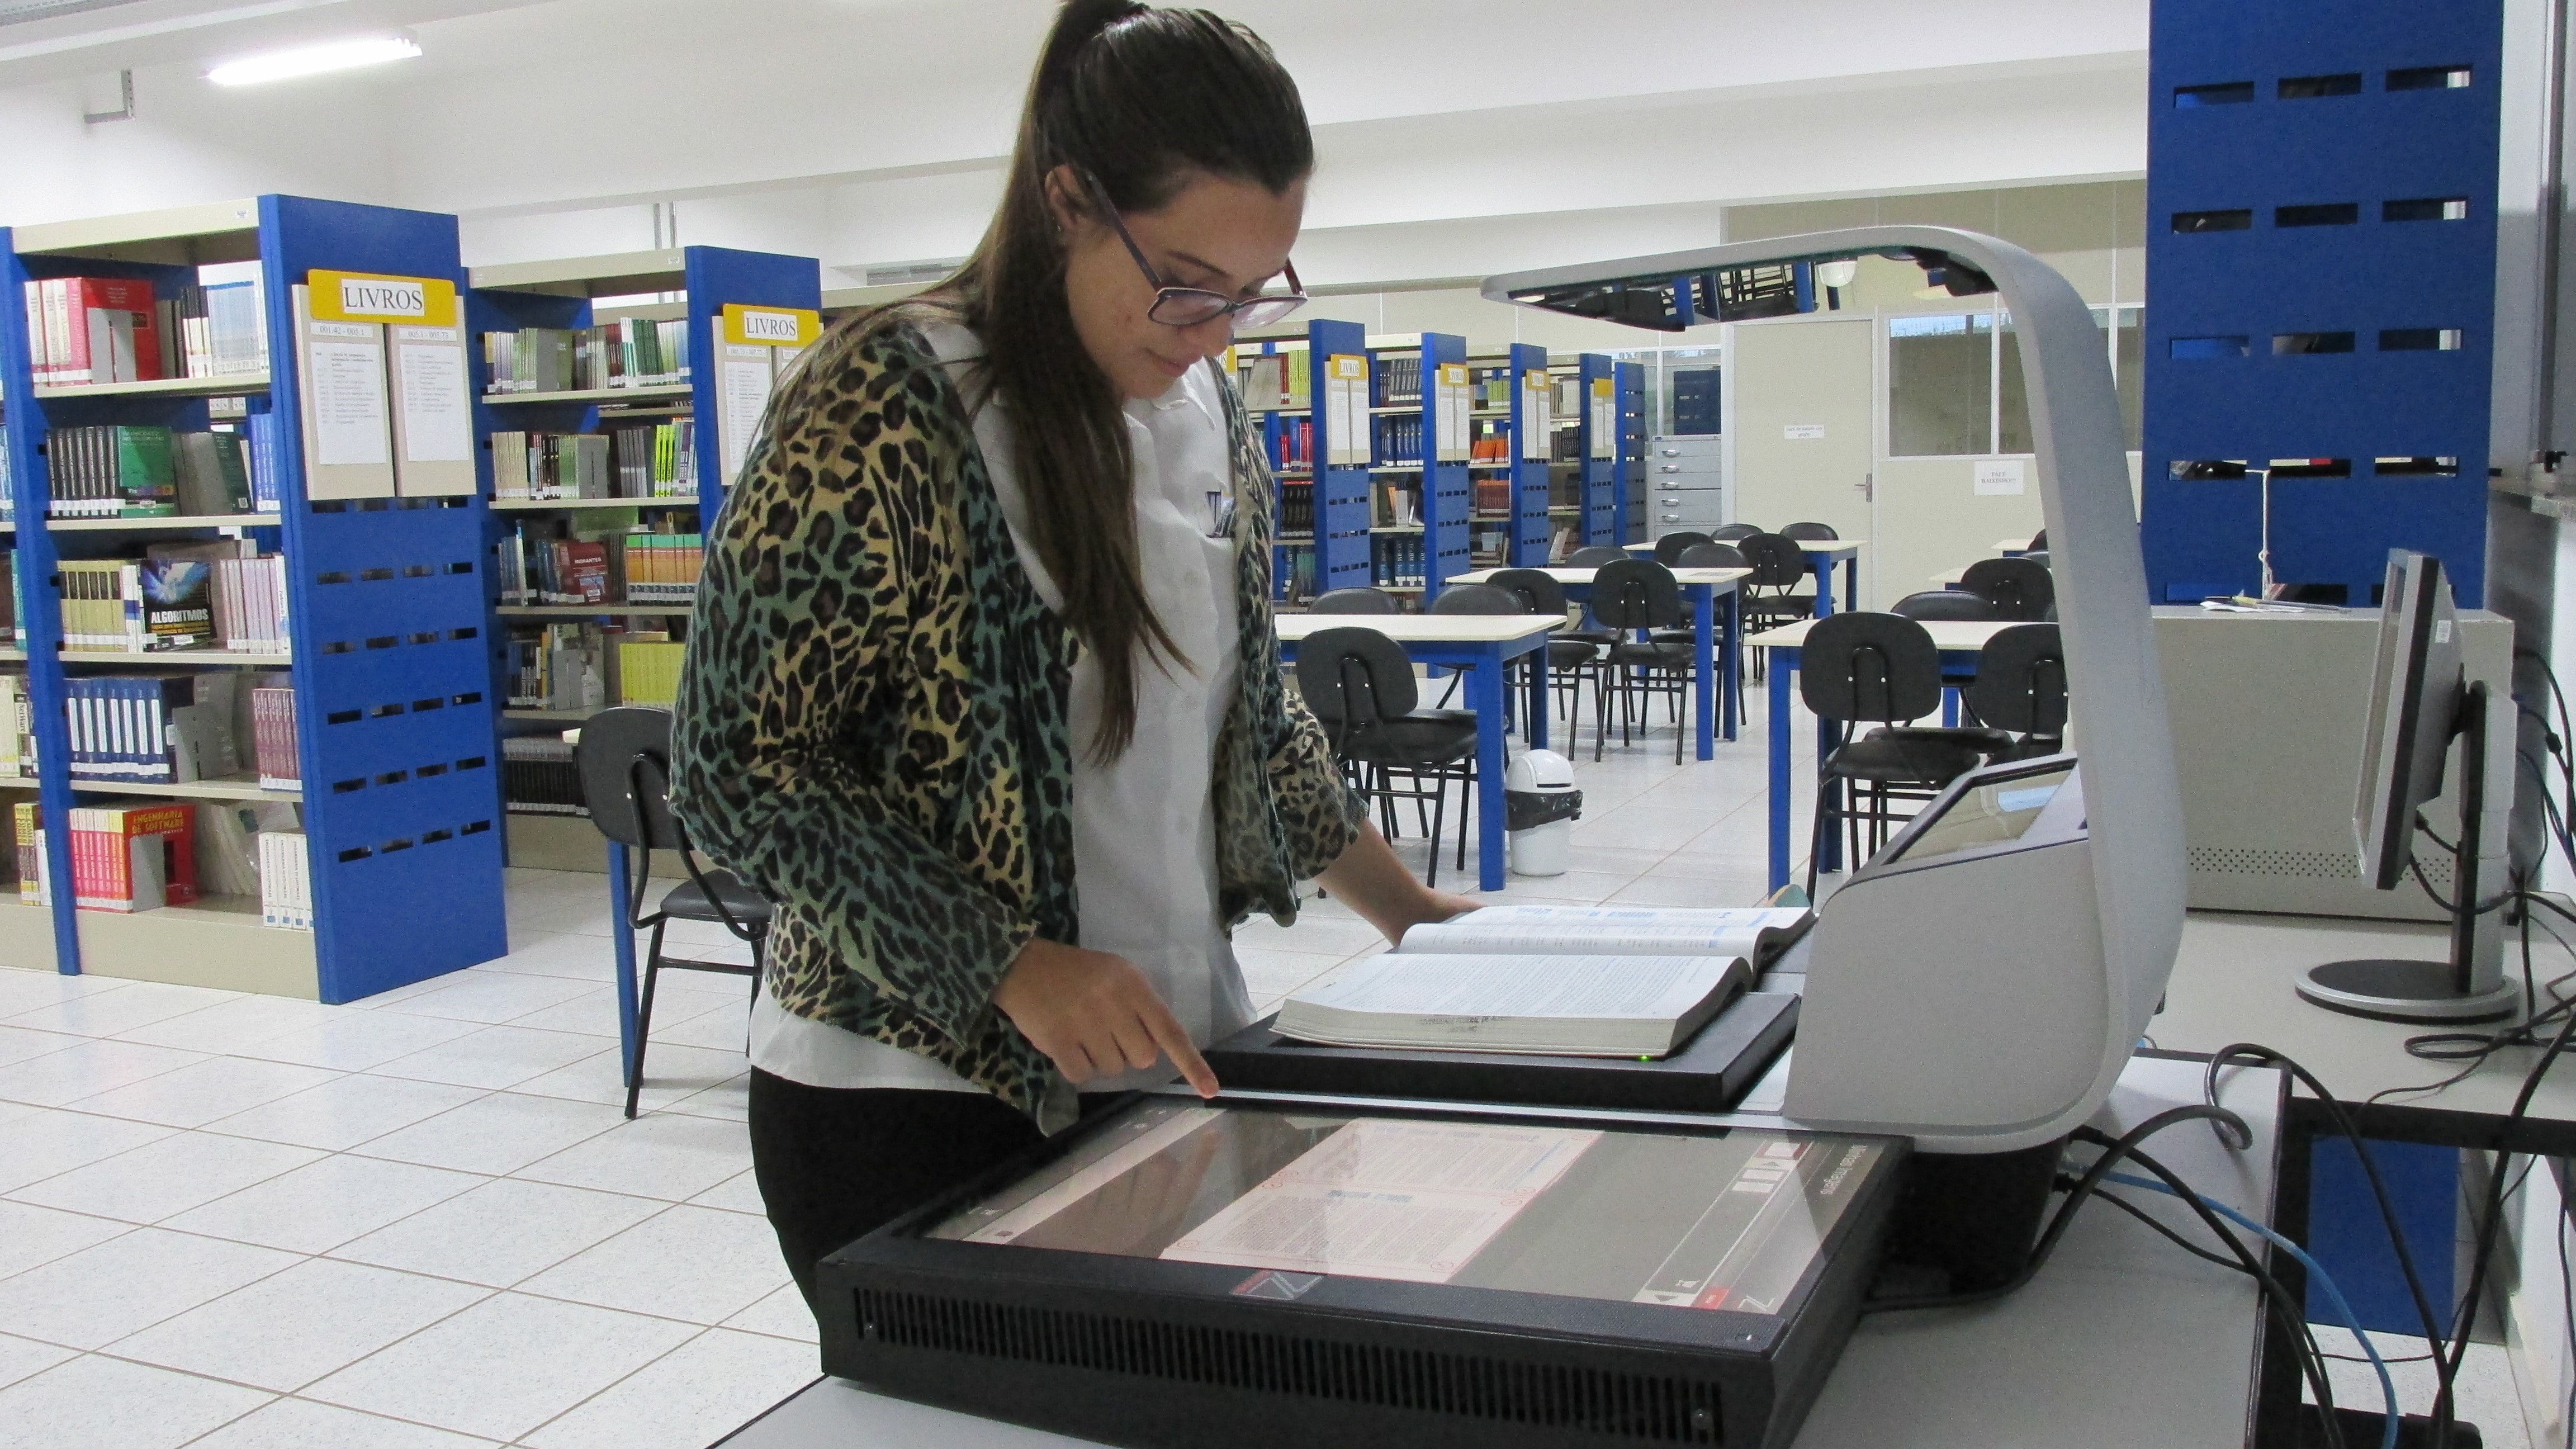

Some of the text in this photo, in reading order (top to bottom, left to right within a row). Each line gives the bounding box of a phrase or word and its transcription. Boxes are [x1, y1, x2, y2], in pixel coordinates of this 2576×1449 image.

[344, 287, 423, 310] LIVROS
[746, 318, 797, 336] LIVROS
[1339, 363, 1360, 374] LIVROS
[151, 608, 209, 624] ALGORITMOS
[134, 810, 183, 823] ENGENHARIA
[132, 818, 183, 834] DE SOFTWARE
